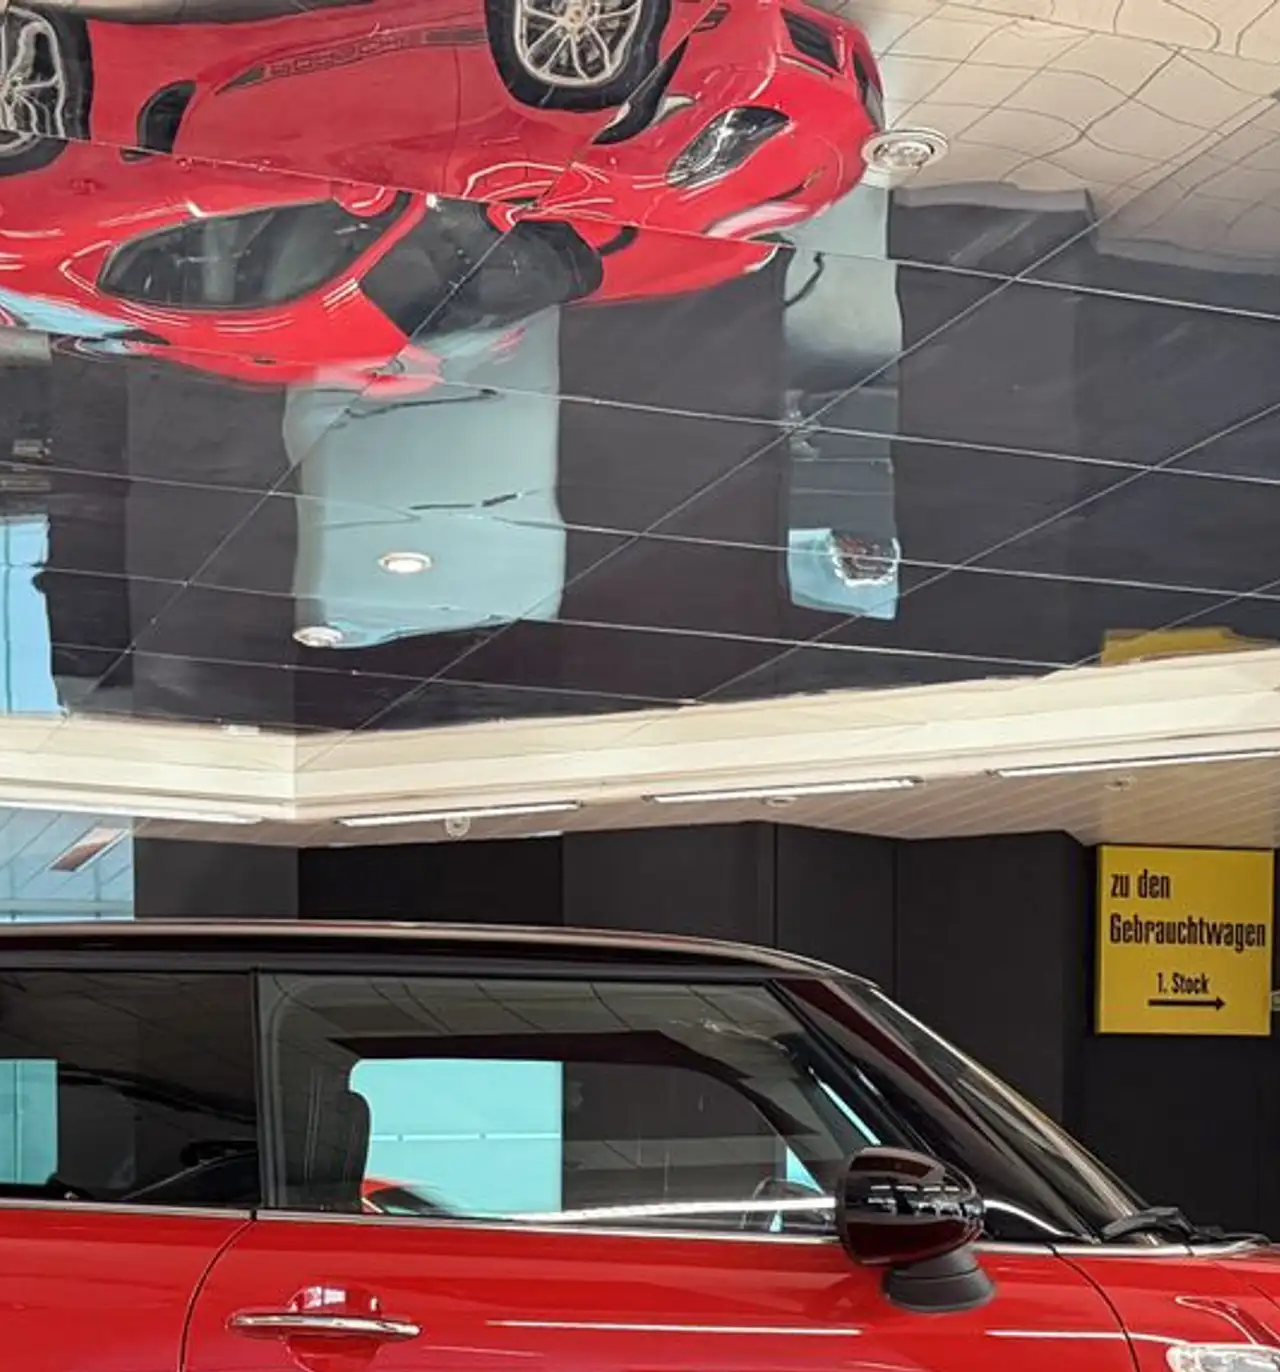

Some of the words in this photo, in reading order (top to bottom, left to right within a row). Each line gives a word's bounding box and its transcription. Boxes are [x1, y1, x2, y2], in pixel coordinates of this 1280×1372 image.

[1110, 873, 1130, 898] zu
[1137, 868, 1170, 898] den
[1109, 912, 1266, 953] Gebrauchtwagen
[1157, 972, 1168, 994] 1.
[1172, 972, 1210, 994] Stock
